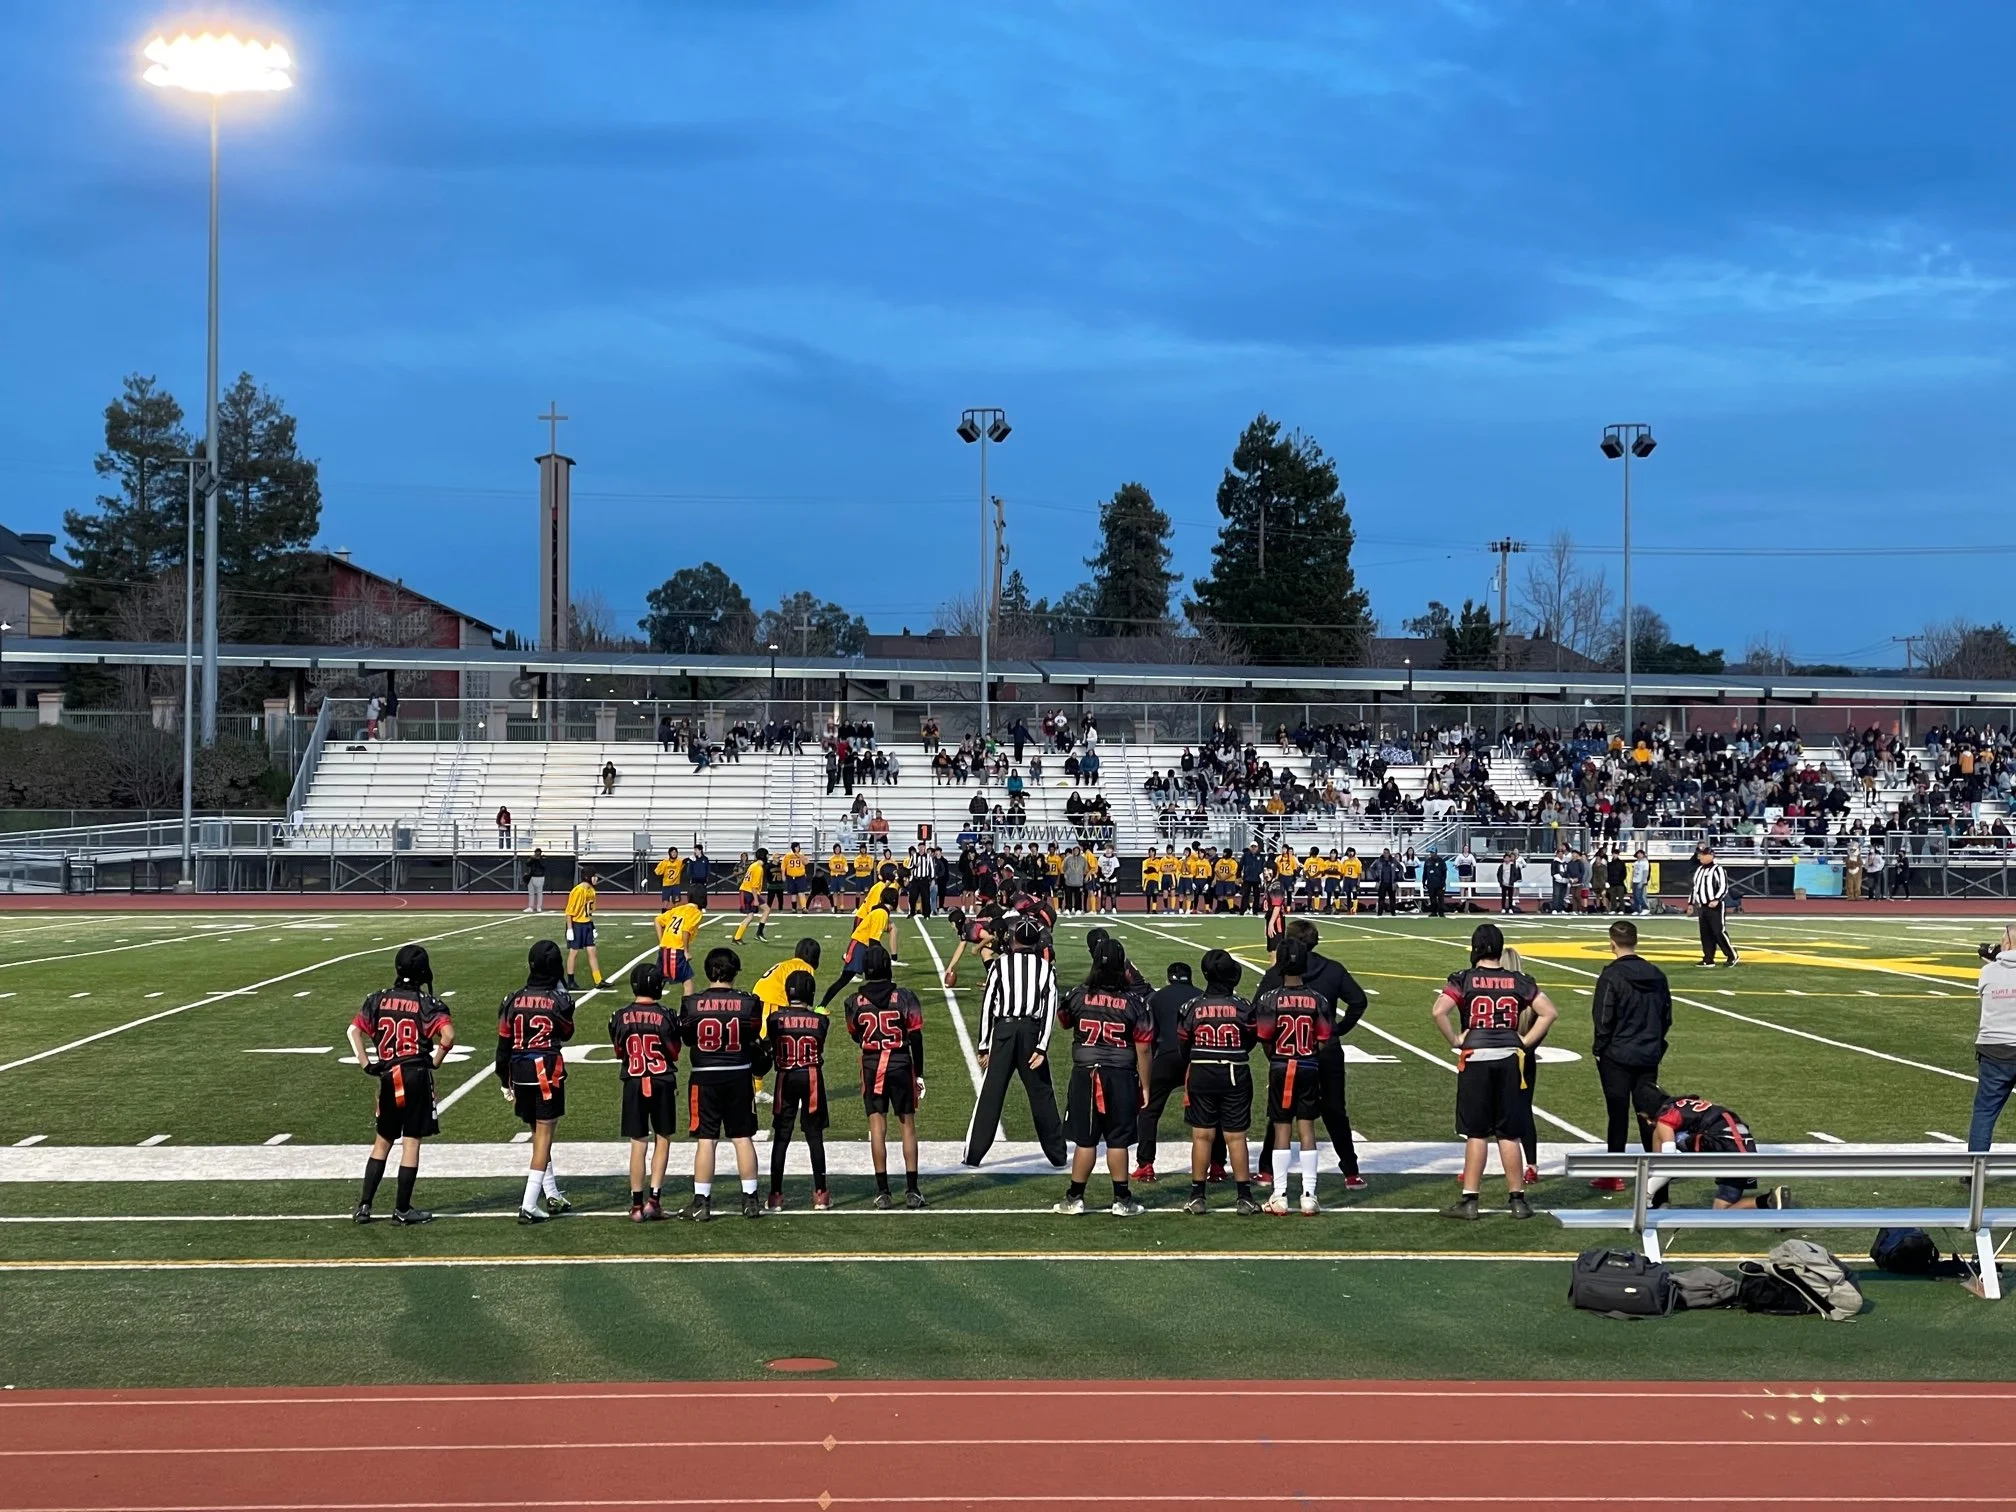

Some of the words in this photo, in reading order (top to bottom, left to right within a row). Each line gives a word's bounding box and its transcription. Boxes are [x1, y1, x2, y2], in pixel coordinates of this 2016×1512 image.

[920, 824, 929, 840] 1
[789, 859, 801, 868] 99
[668, 869, 676, 880] 2
[1472, 976, 1515, 990] CANYON
[380, 998, 420, 1014] CANYON
[514, 996, 555, 1010] CANYON
[696, 998, 742, 1012] CANYON
[1277, 995, 1316, 1010] CANYON
[622, 1011, 664, 1026] CANYON
[1194, 1005, 1238, 1019] CANYON
[1469, 995, 1519, 1030] 83
[512, 1013, 554, 1050] 12
[697, 1017, 742, 1052] 81
[858, 1010, 903, 1050] 25
[1079, 1018, 1127, 1048] 75
[1275, 1014, 1314, 1056] 20
[377, 1016, 419, 1061] 28
[626, 1033, 667, 1076] 85
